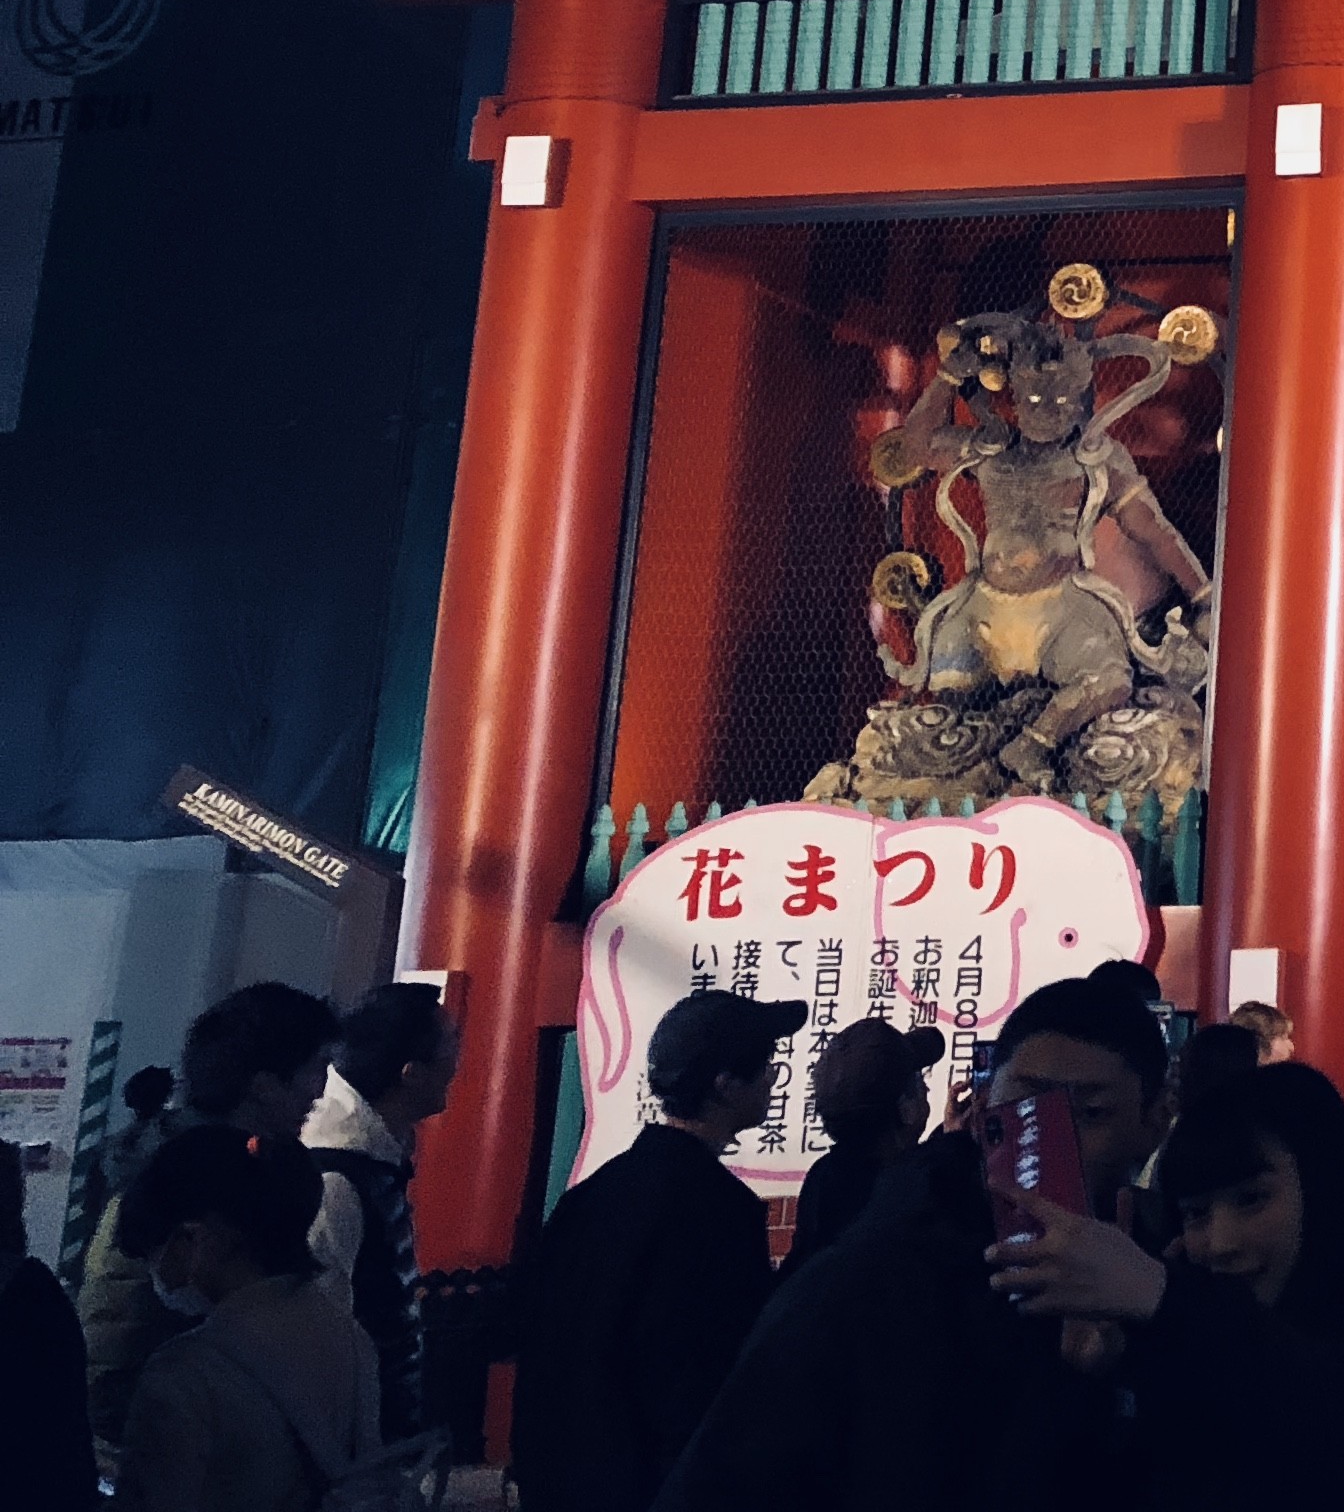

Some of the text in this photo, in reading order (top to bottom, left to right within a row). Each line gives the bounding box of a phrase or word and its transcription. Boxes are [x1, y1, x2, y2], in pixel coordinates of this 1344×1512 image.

[194, 783, 308, 854] KAMINARIMON
[304, 846, 349, 879] GATE
[676, 841, 1017, 922] 花まつり
